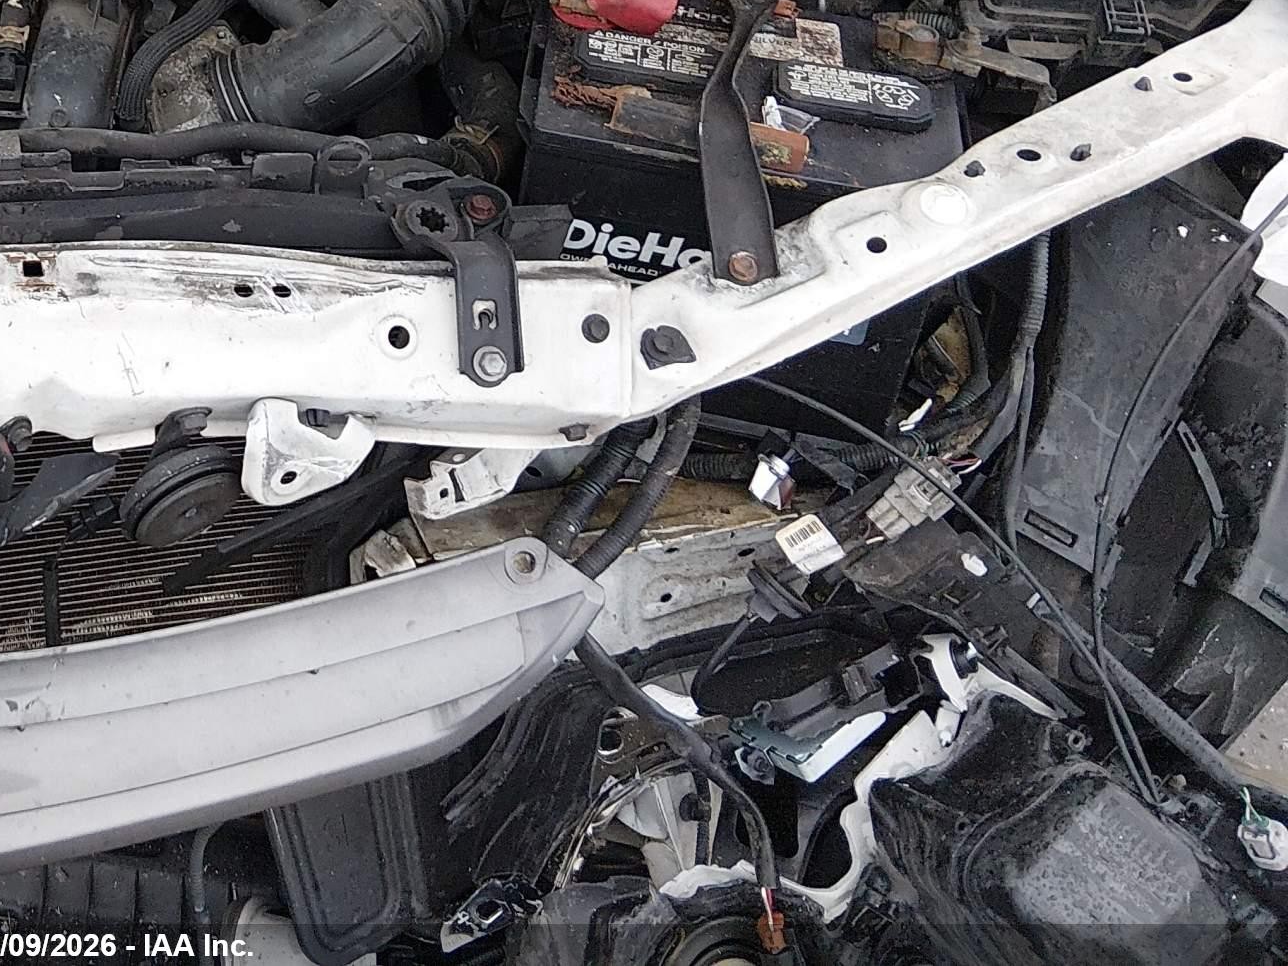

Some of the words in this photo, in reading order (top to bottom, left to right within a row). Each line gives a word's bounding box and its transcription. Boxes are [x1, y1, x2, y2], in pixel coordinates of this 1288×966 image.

[606, 31, 652, 46] DANGER
[663, 40, 706, 54] POISON
[563, 218, 712, 269] DieHa
[607, 262, 659, 277] AHEAD
